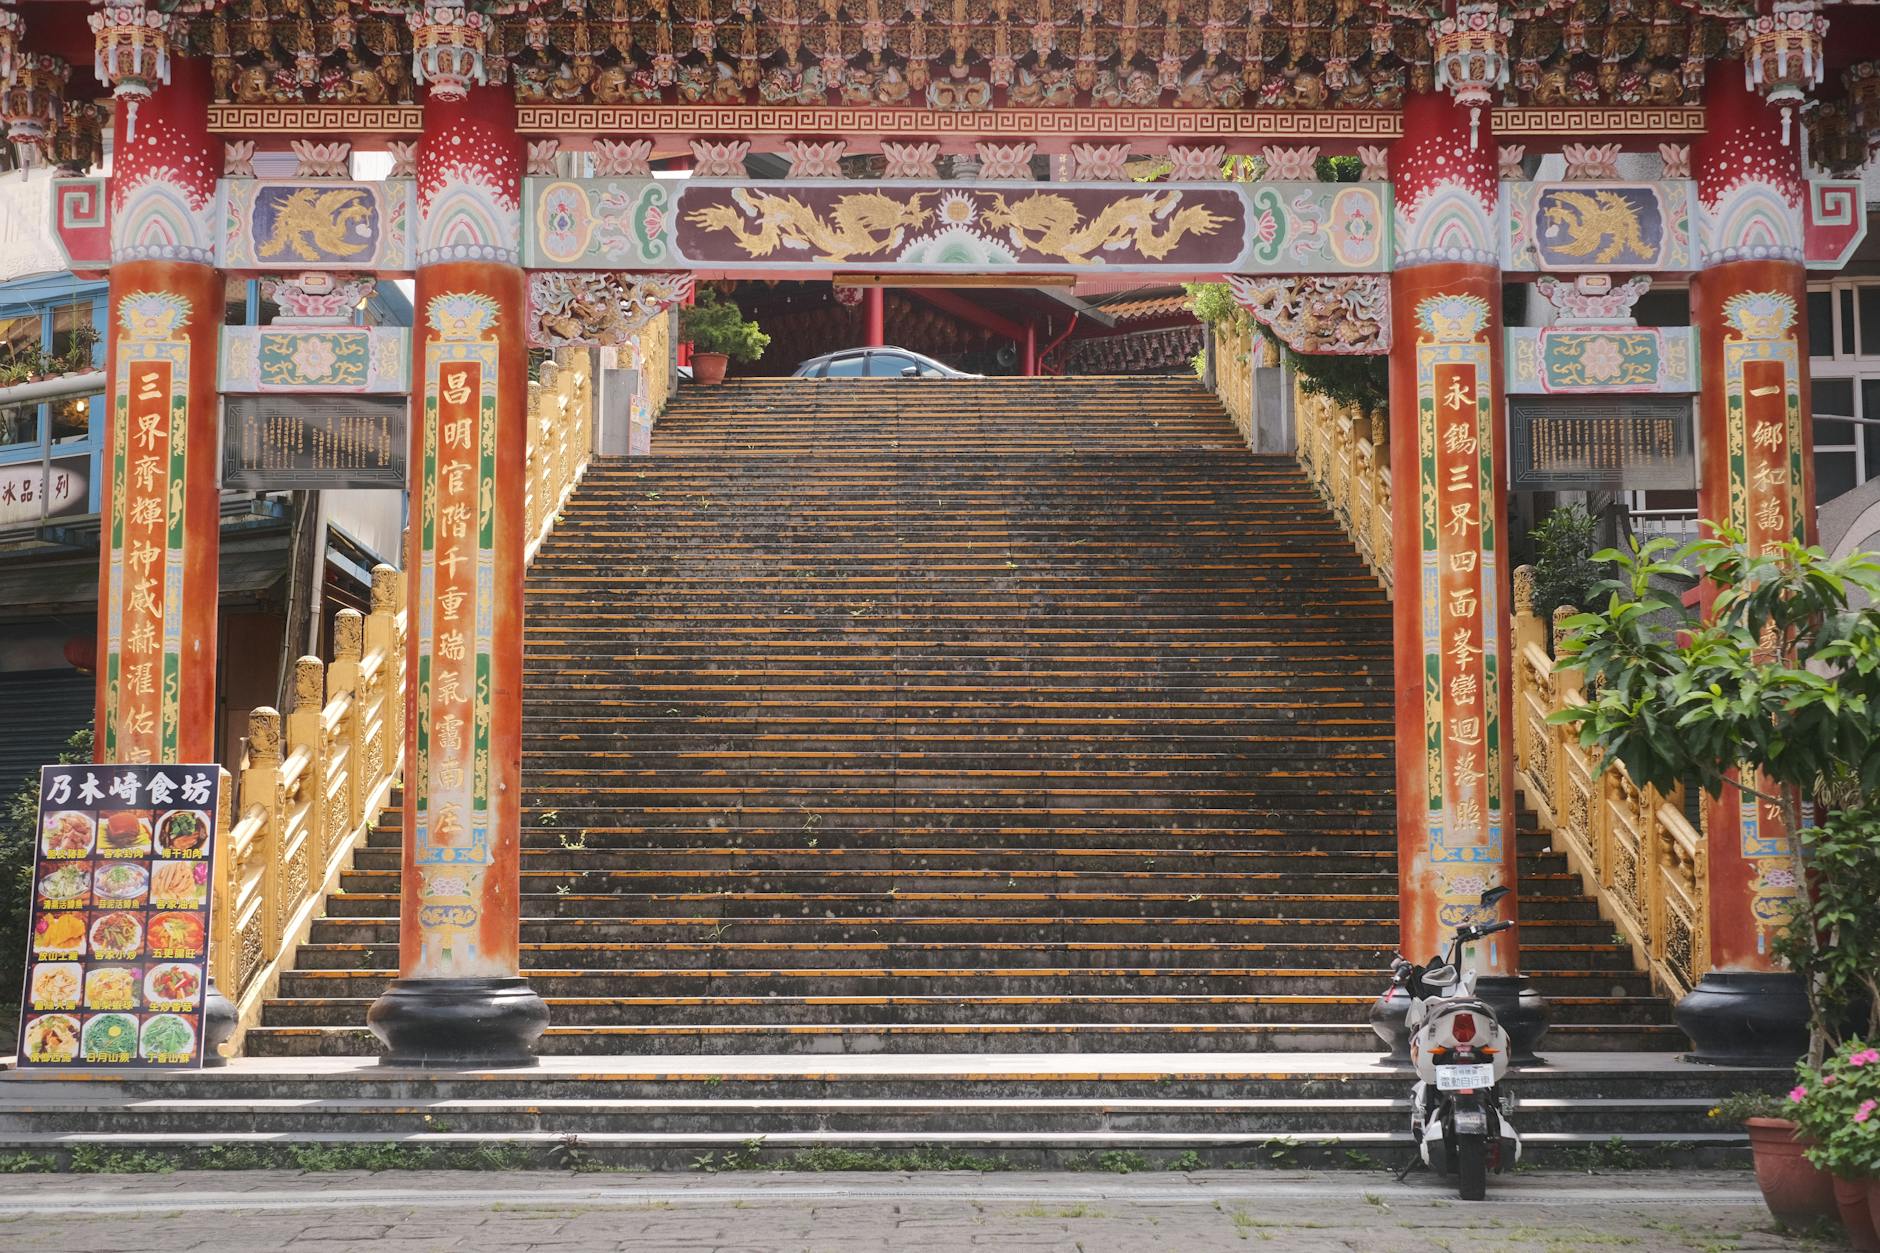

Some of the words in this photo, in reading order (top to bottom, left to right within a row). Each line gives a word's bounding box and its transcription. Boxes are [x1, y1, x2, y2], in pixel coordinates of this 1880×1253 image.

[2, 473, 69, 506] 冰品列
[46, 771, 213, 806] 乃木崎食坊
[94, 950, 137, 960] 客家小炒
